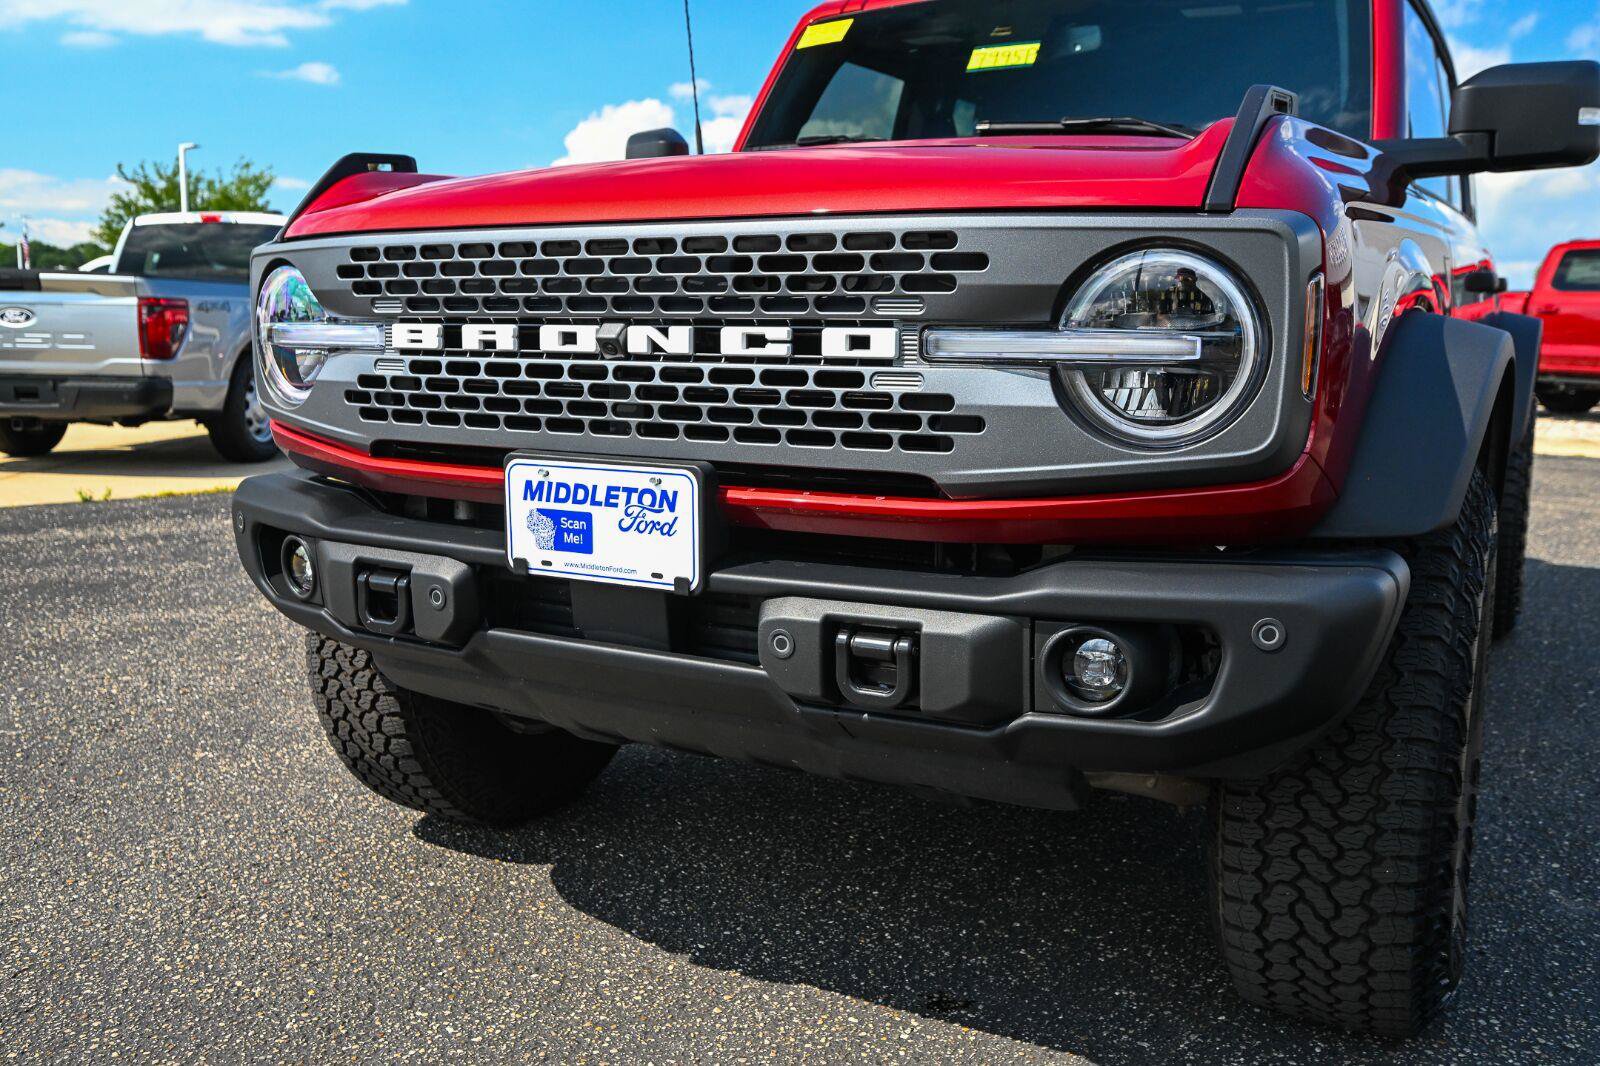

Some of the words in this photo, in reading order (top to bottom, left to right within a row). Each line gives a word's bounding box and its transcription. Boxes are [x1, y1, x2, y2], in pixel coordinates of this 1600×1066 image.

[391, 323, 899, 359] BRONCO
[522, 479, 679, 513] MIDDLETON
[560, 517, 587, 530] Scan
[618, 504, 679, 537] Ford
[563, 533, 583, 544] Me!
[563, 562, 638, 575] www.MiddletonFord.com
